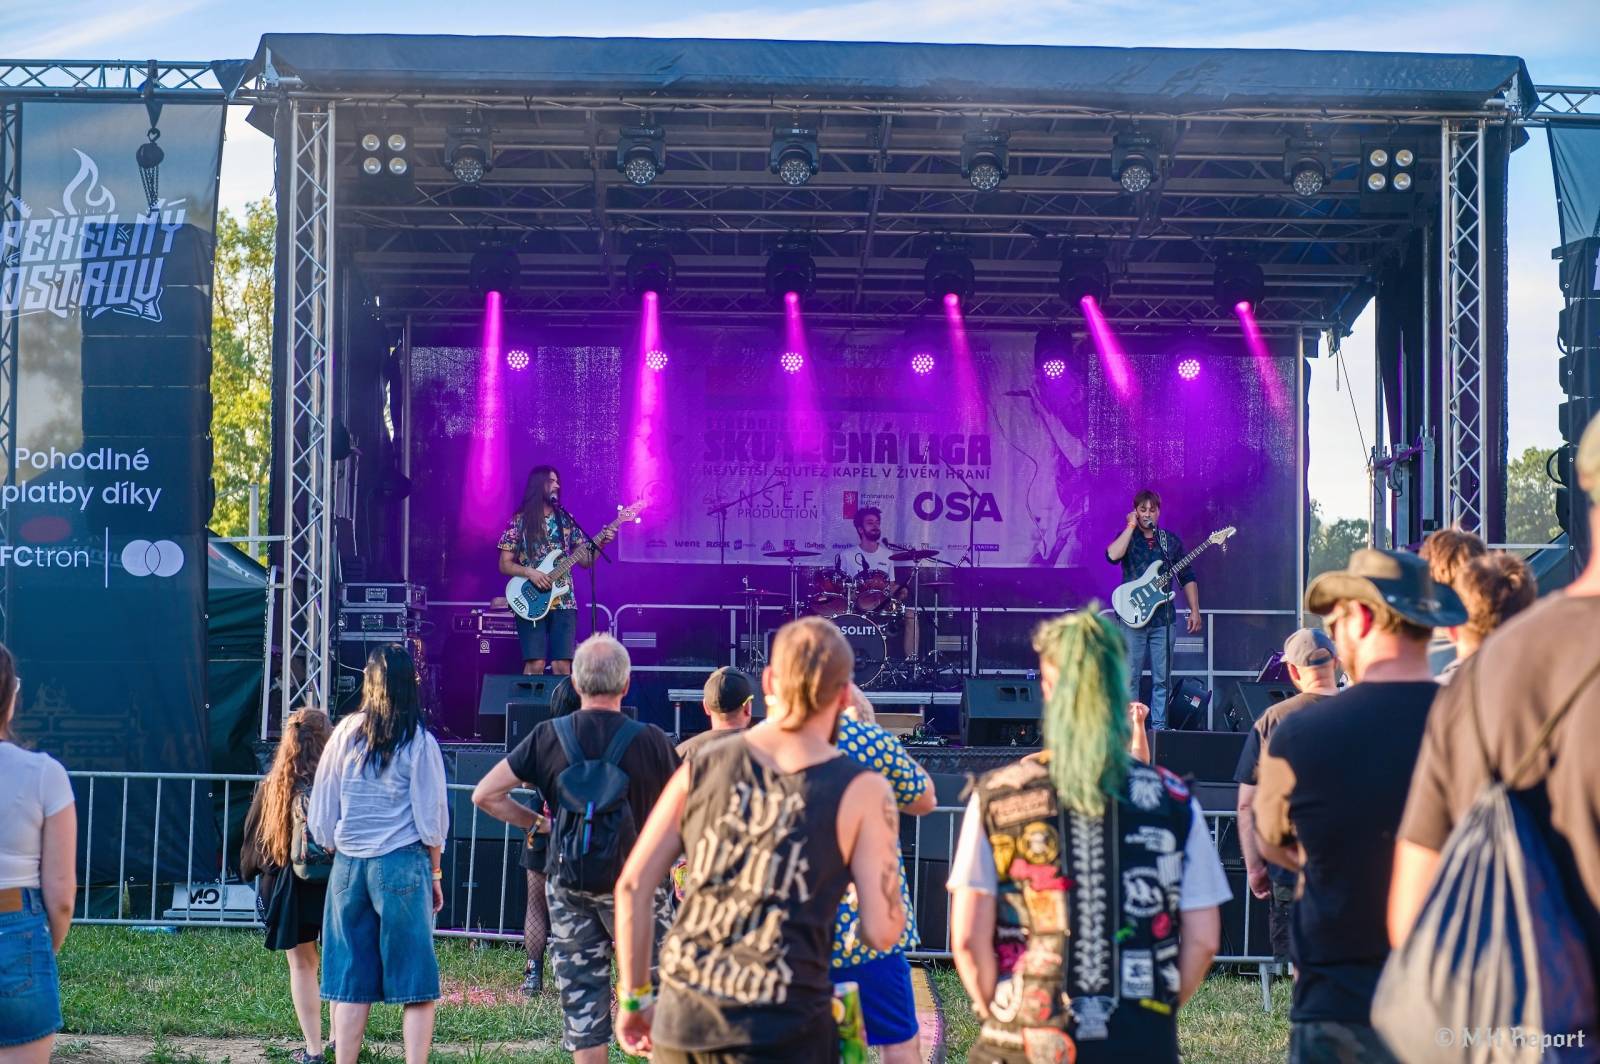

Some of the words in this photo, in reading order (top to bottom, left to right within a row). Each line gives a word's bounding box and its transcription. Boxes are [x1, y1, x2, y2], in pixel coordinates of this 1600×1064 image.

[15, 446, 150, 471] Pohodlné
[908, 432, 992, 466] LIGA
[832, 466, 877, 478] KAPEL
[882, 467, 891, 478] V
[896, 465, 940, 479] ŽIVÉM
[945, 467, 991, 480] HRANÍ
[1, 480, 94, 511] platby
[102, 480, 162, 512] díky
[913, 491, 1003, 522] OSA
[737, 508, 818, 520] PRODUCTION
[0, 545, 89, 568] FCtron
